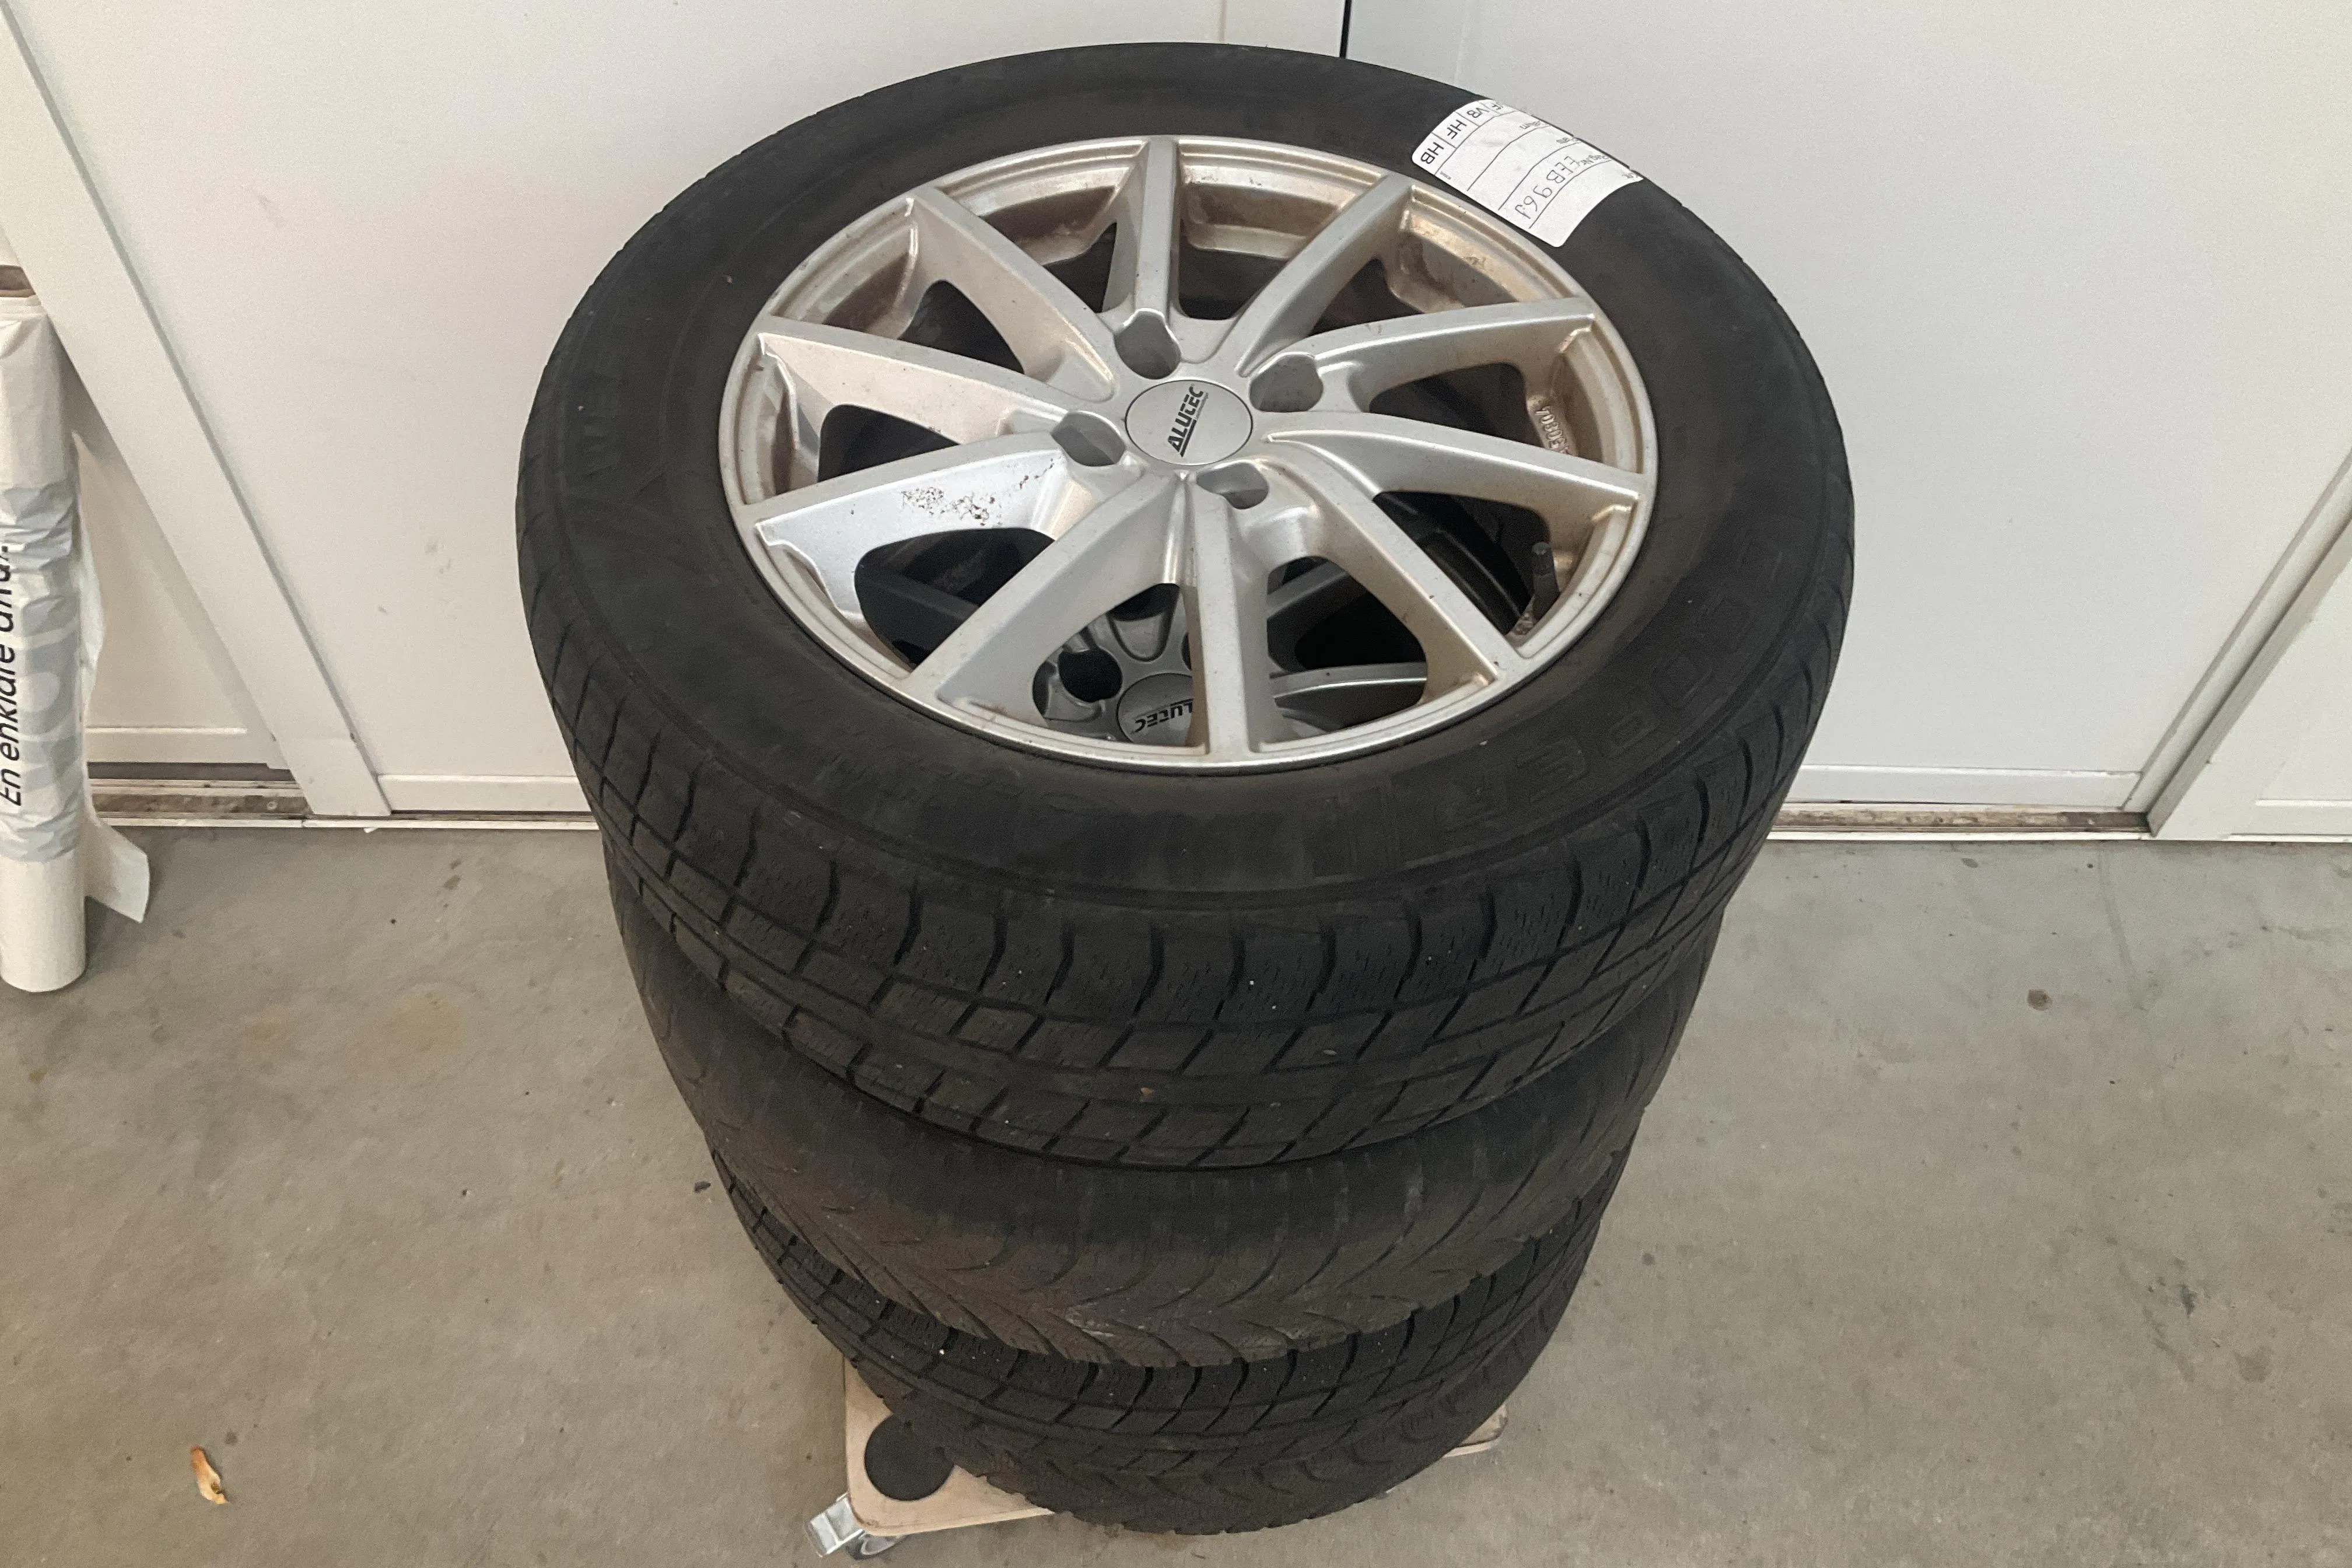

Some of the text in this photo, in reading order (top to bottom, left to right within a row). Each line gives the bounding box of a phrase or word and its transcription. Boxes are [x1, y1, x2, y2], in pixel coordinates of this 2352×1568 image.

[1466, 107, 1490, 118] VB
[1446, 119, 1468, 140] HF
[1420, 142, 1445, 164] HB
[1167, 385, 1205, 453] ALUTEC
[1133, 701, 1193, 733] LUTEC
[0, 767, 21, 806] En
